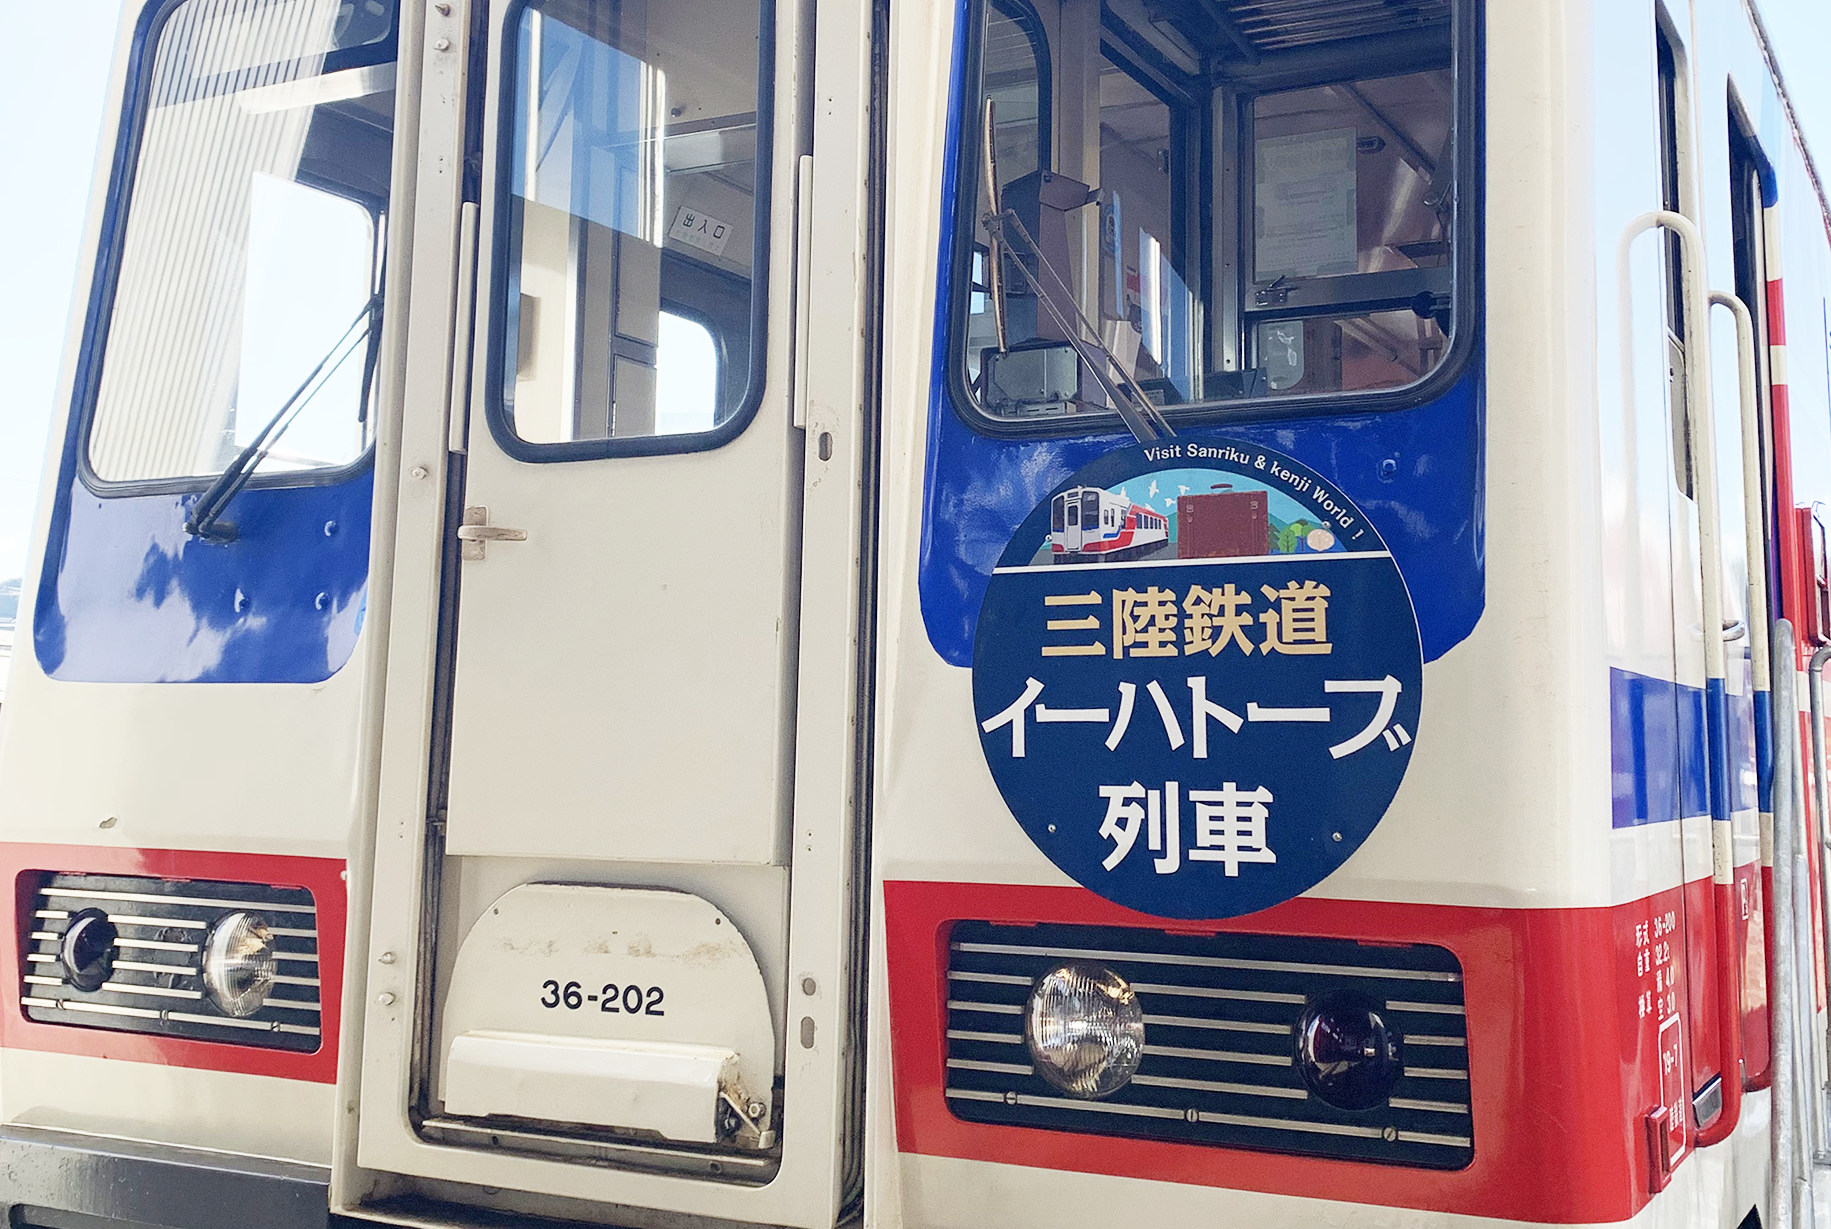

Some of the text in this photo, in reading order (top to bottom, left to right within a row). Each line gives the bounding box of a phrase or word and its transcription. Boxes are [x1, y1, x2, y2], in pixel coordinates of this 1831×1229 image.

[683, 213, 725, 239] 出入口
[1144, 445, 1181, 462] Visit
[1186, 443, 1250, 464] Sanriku
[1254, 455, 1266, 470] &
[1312, 486, 1354, 529] World
[1041, 580, 1333, 659] 三陸鉄道
[980, 674, 1412, 760] イーハトーブ
[1099, 781, 1277, 877] 列車
[540, 979, 665, 1017] 36-202
